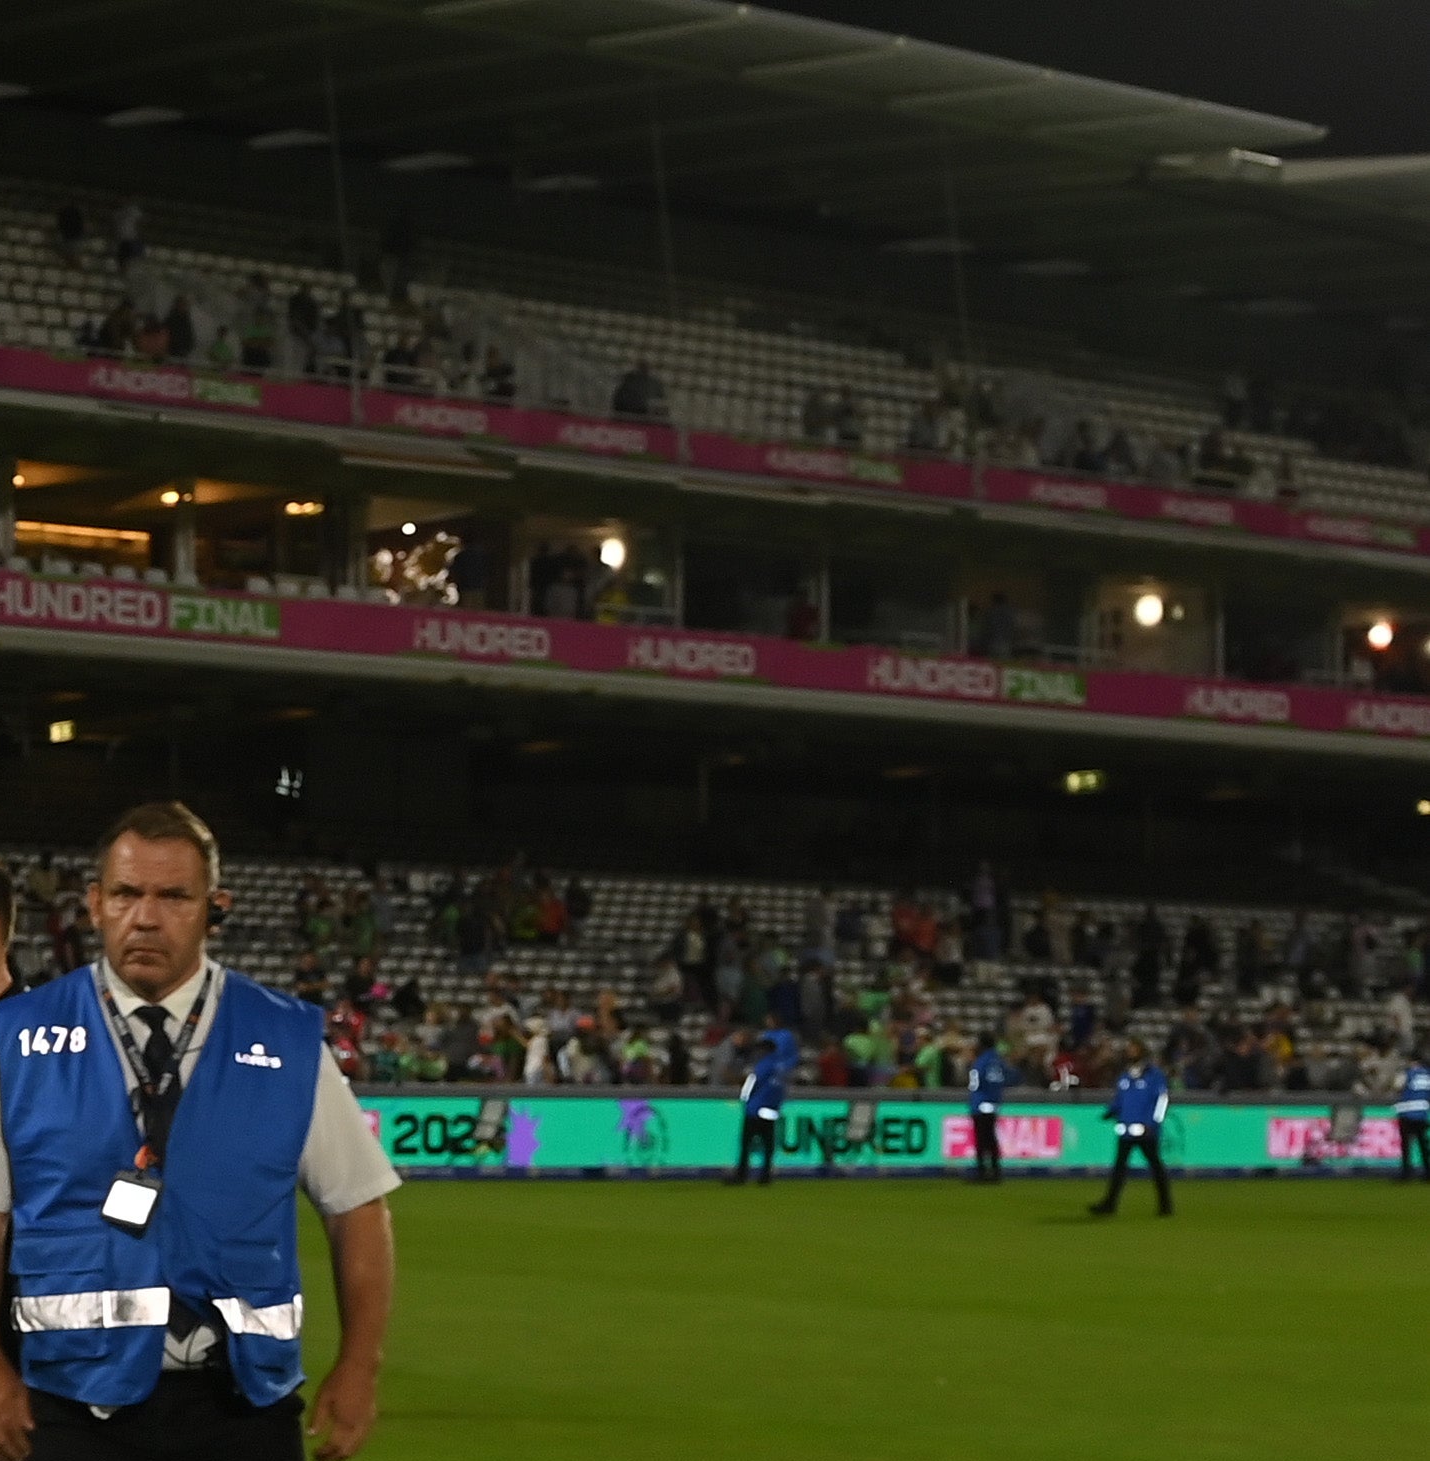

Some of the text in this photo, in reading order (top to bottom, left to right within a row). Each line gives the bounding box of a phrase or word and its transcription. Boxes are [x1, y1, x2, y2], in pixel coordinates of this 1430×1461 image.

[170, 594, 280, 638] FINAL
[414, 618, 551, 660] HUNDRED
[628, 635, 756, 676] HUNDRED
[867, 655, 997, 698] HUNDRED
[18, 1025, 87, 1056] 1478
